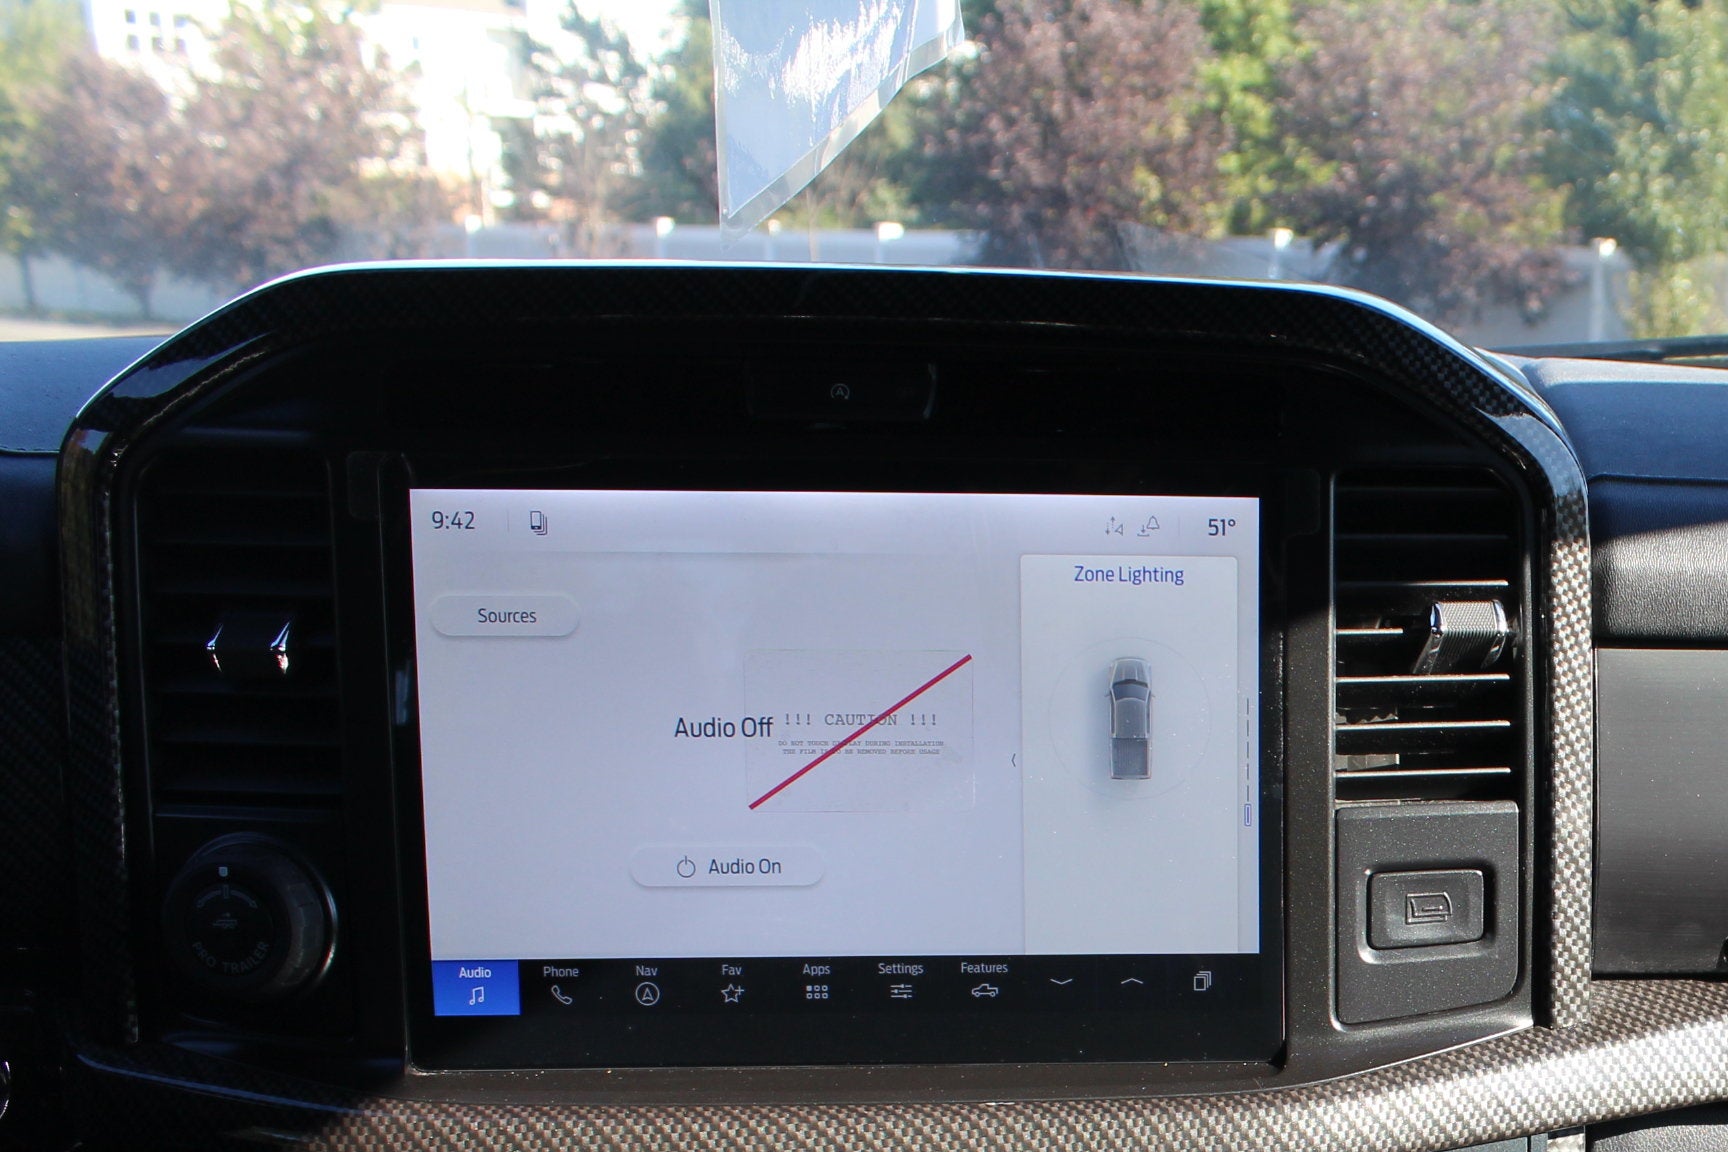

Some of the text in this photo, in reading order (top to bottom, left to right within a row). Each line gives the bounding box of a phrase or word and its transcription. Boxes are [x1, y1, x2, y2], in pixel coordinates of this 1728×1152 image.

[431, 510, 476, 530] 9:42
[1207, 518, 1237, 537] 51°
[1074, 565, 1185, 585] Zone Lighting
[477, 607, 537, 624] Sources
[674, 716, 774, 738] Audio Off
[824, 713, 898, 726] CAUTION
[708, 857, 782, 875] Audio On
[459, 966, 492, 979] Audio
[543, 965, 579, 978] Phone
[635, 964, 658, 977] Nav
[721, 964, 742, 976] Fav
[802, 963, 831, 979] Apps
[878, 962, 924, 979] Settings
[960, 961, 1008, 974] Features
